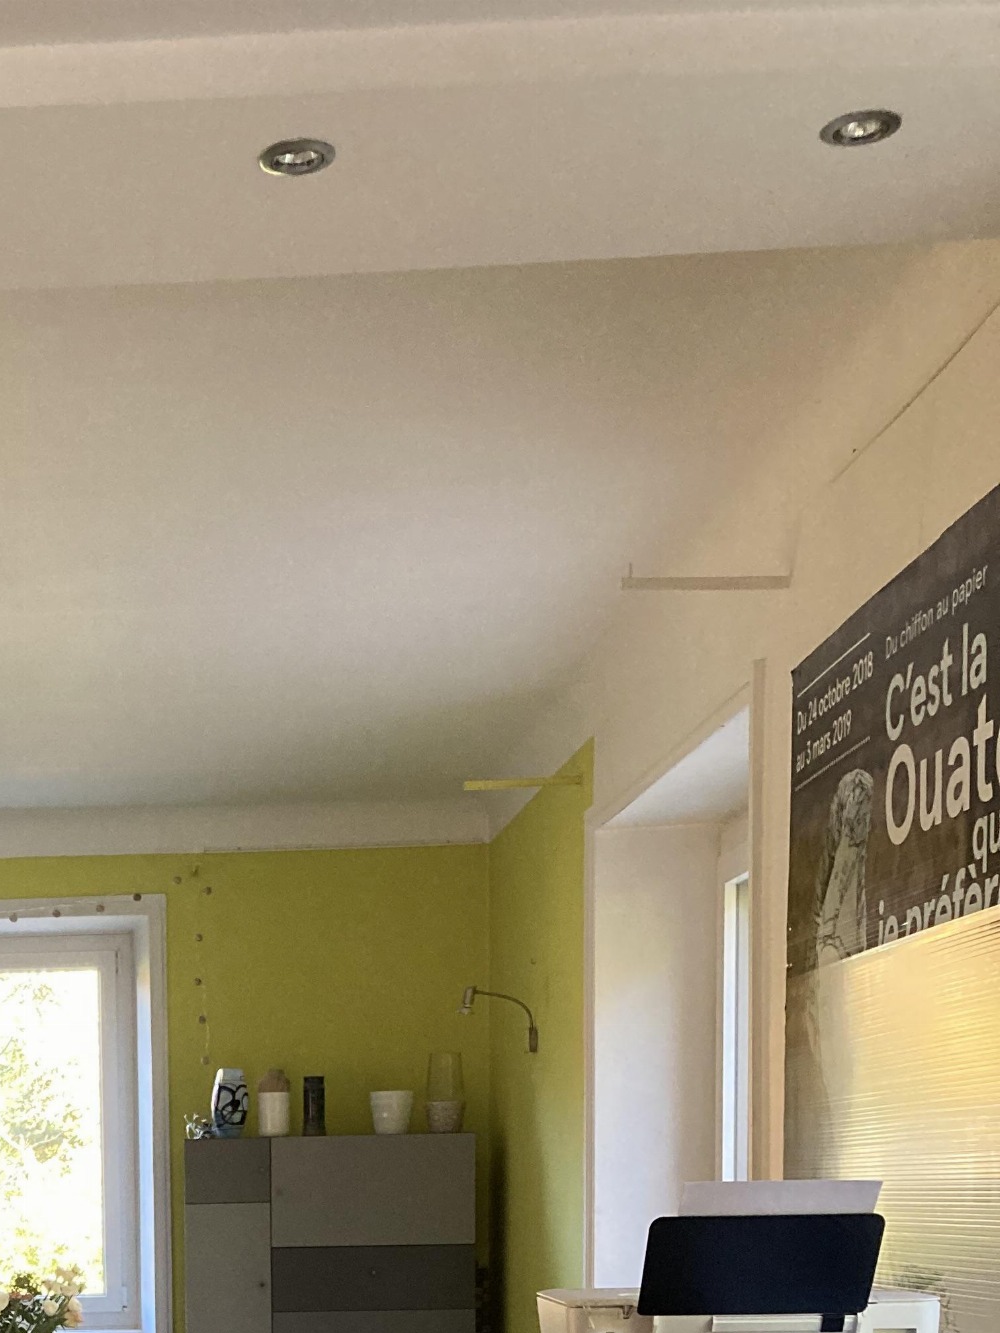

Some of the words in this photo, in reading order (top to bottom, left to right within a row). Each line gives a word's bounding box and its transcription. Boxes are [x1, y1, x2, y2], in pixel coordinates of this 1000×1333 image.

[885, 636, 898, 659] Du
[936, 596, 949, 620] au
[952, 564, 989, 616] papier
[797, 711, 807, 735] Du
[808, 697, 818, 726] 24
[818, 676, 851, 716] octobre
[852, 651, 873, 691] 2018
[885, 637, 953, 741] C'est
[961, 622, 987, 696] la
[806, 741, 811, 765] 3
[812, 732, 831, 760] mars
[832, 709, 852, 746] 2019
[885, 692, 1000, 846] Ouat
[905, 863, 1000, 936] préfèr
